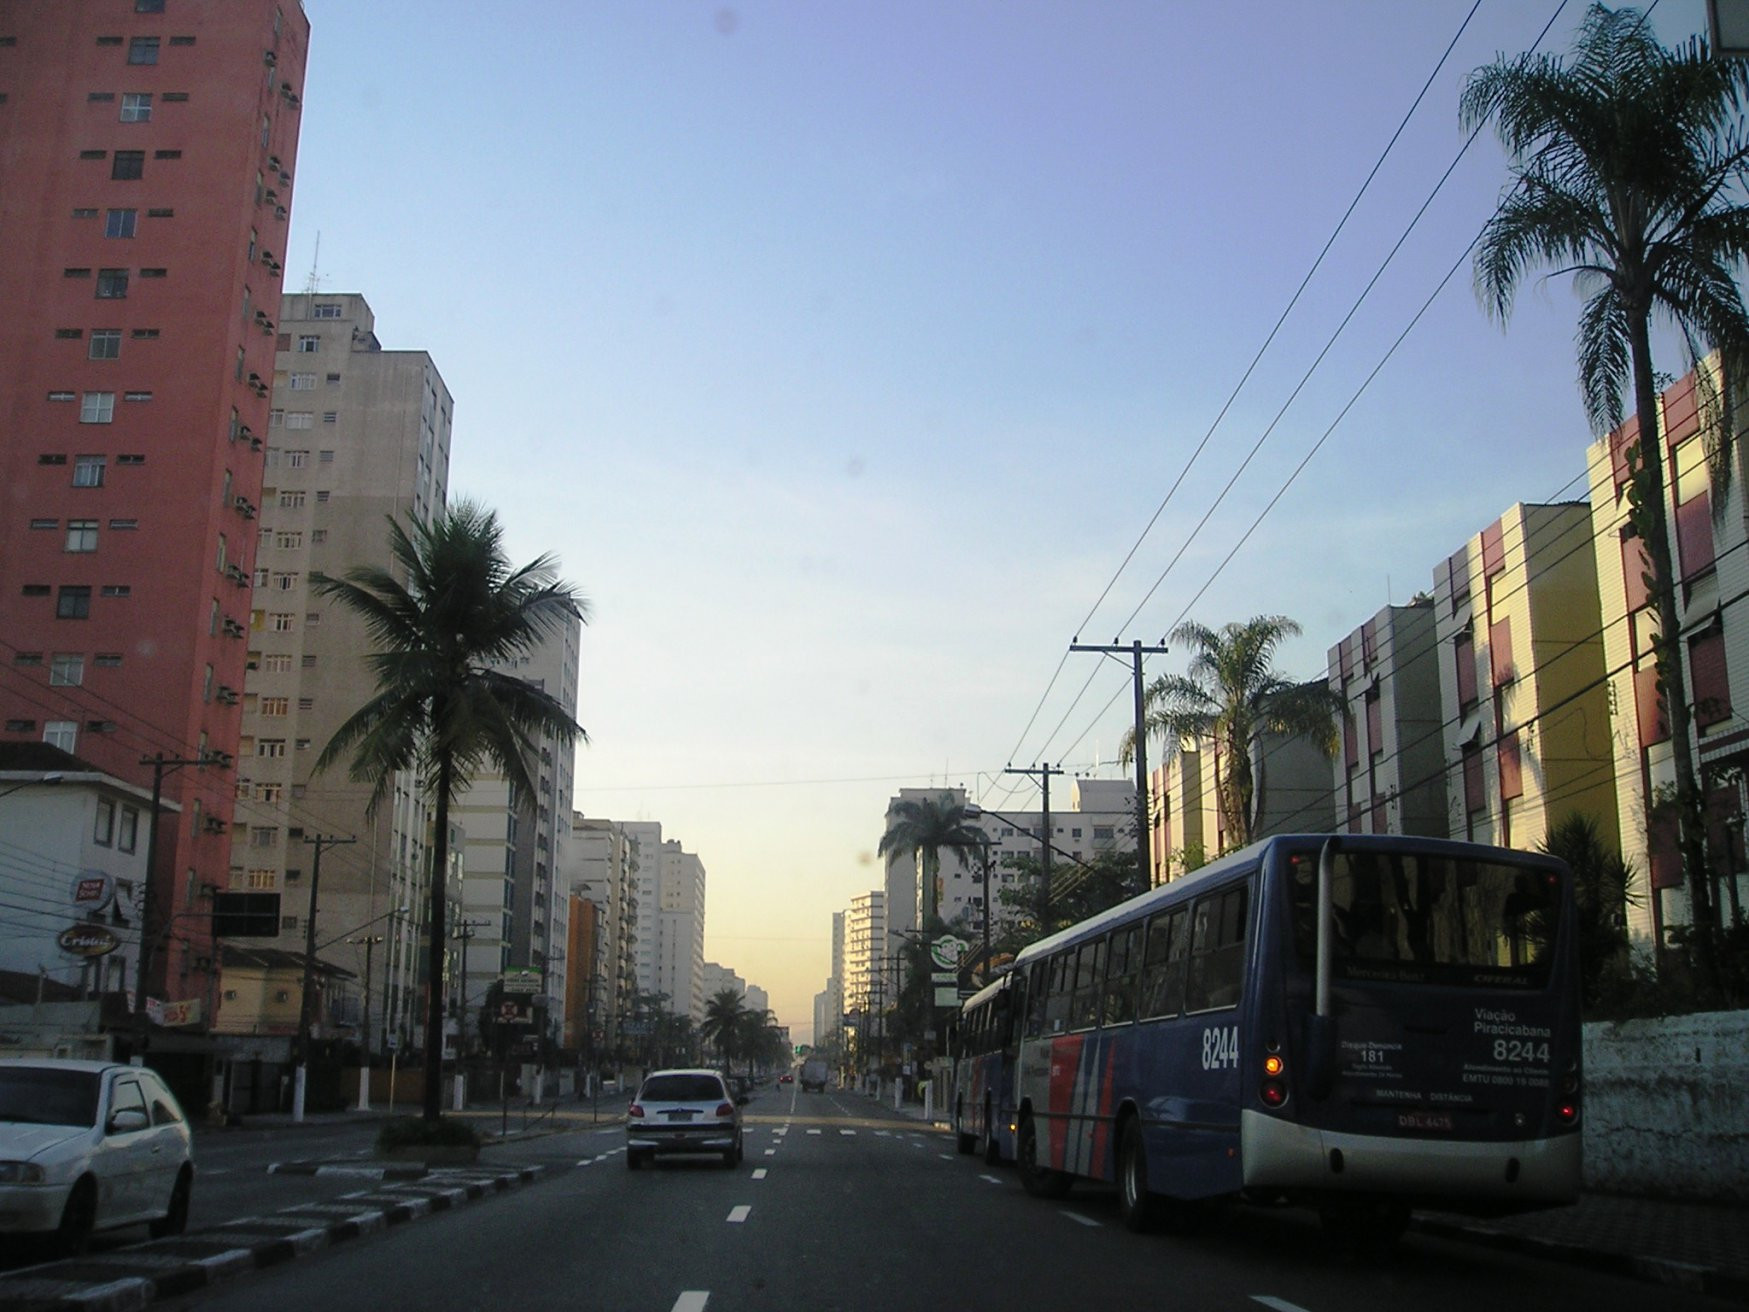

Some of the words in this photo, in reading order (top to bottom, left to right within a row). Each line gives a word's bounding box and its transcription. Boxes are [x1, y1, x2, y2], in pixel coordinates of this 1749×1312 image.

[1474, 1008, 1516, 1024] Viação
[1474, 1021, 1552, 1038] Piracicabana
[1202, 1026, 1240, 1071] 8244
[1361, 1050, 1384, 1063] 181
[1493, 1039, 1551, 1063] 8244
[1462, 1073, 1490, 1084] EMTU
[1376, 1089, 1423, 1101] MANTENHA
